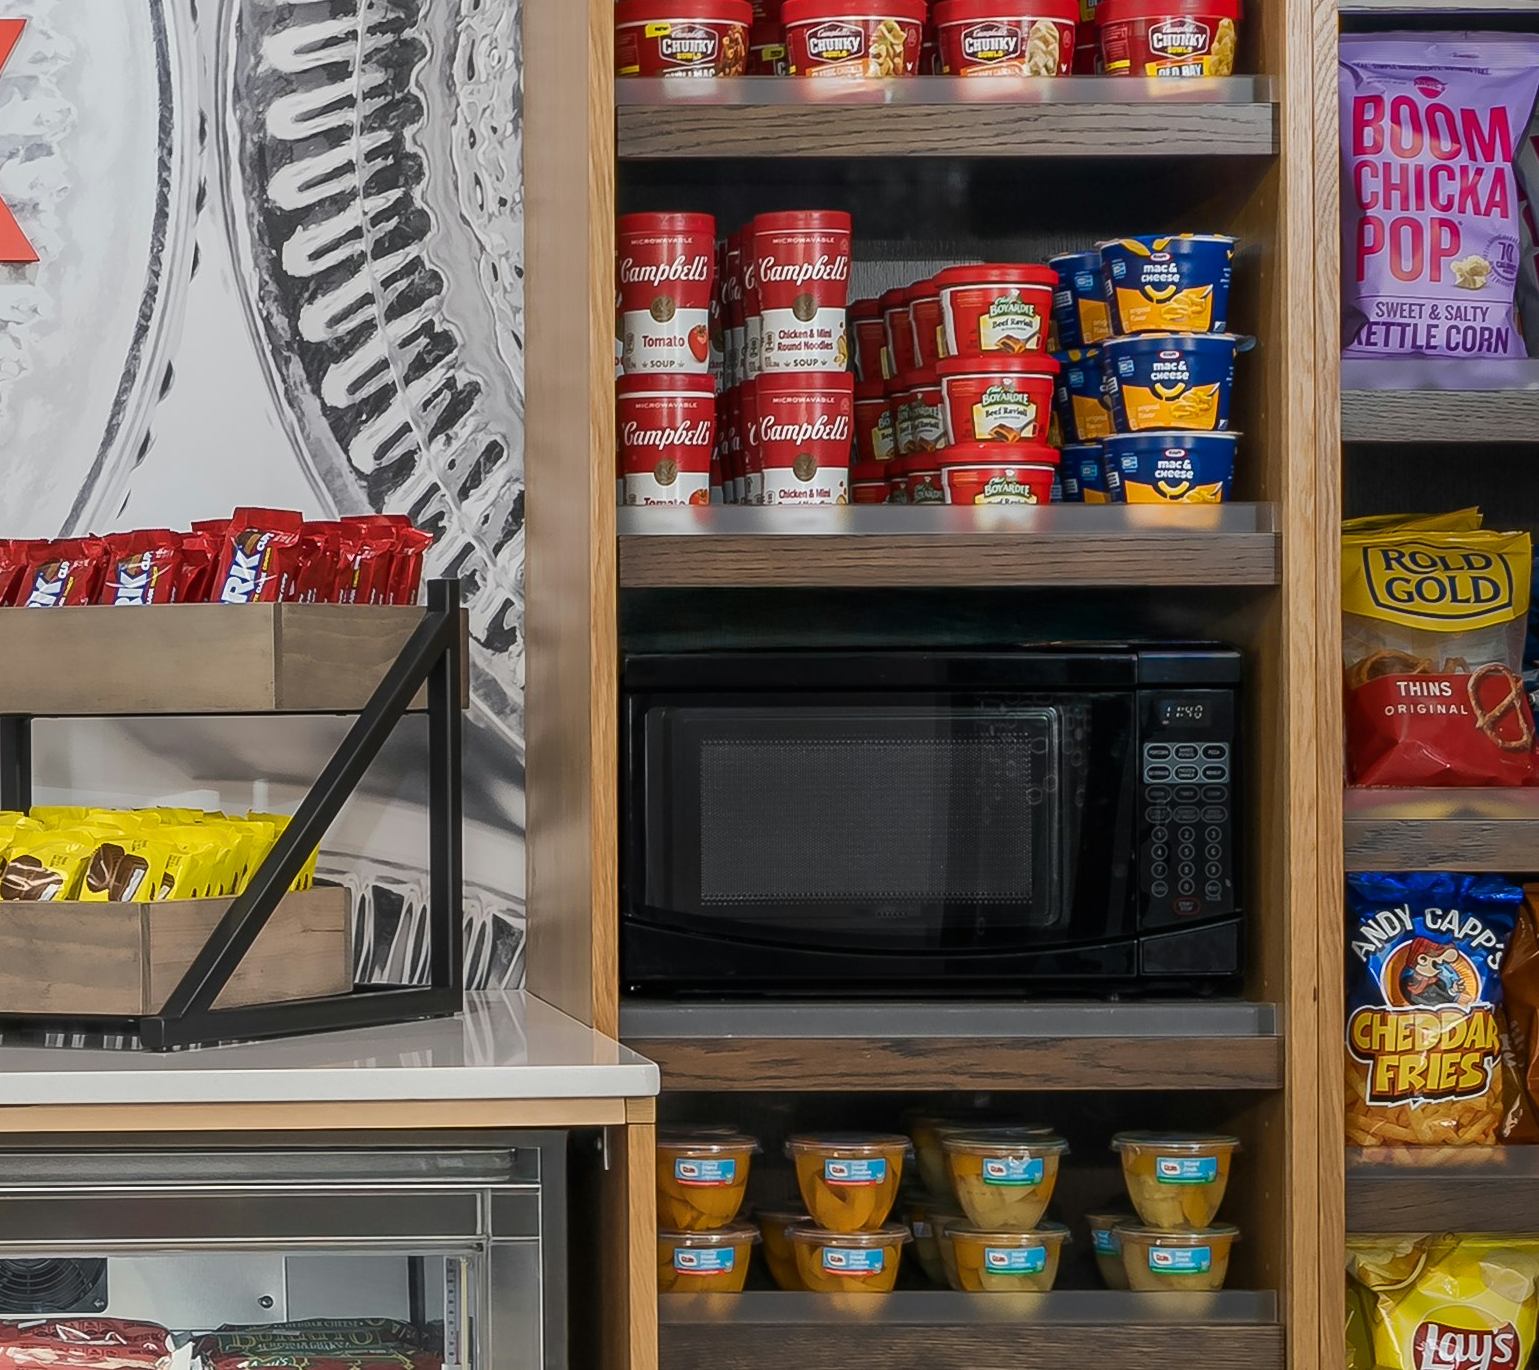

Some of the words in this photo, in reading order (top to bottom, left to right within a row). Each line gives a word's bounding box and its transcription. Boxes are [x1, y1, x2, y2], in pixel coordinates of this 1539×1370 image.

[1352, 95, 1513, 165] BOOM
[1353, 159, 1510, 219] CHICKA
[1355, 216, 1462, 285] POP
[621, 255, 708, 286] Campbell's
[1375, 304, 1425, 323] SWEET
[1429, 305, 1440, 321] &
[1442, 304, 1489, 323] SALTY
[642, 335, 685, 347] Tomato
[777, 342, 801, 351] Round
[803, 341, 833, 350] Noodles
[778, 330, 807, 340] Chicken
[650, 360, 675, 368] SOUP
[793, 359, 818, 367] SOUP
[1382, 546, 1492, 576] ROLD
[1384, 571, 1502, 604] GOLD
[1396, 680, 1452, 698] THINS
[1166, 705, 1203, 719] 11:40
[1385, 703, 1469, 716] ORIGINAL
[1352, 903, 1414, 962] ANDY
[1425, 907, 1505, 970] CAPP'S
[1352, 1011, 1500, 1053] CHEDDAR
[1374, 1055, 1486, 1091] FRIES
